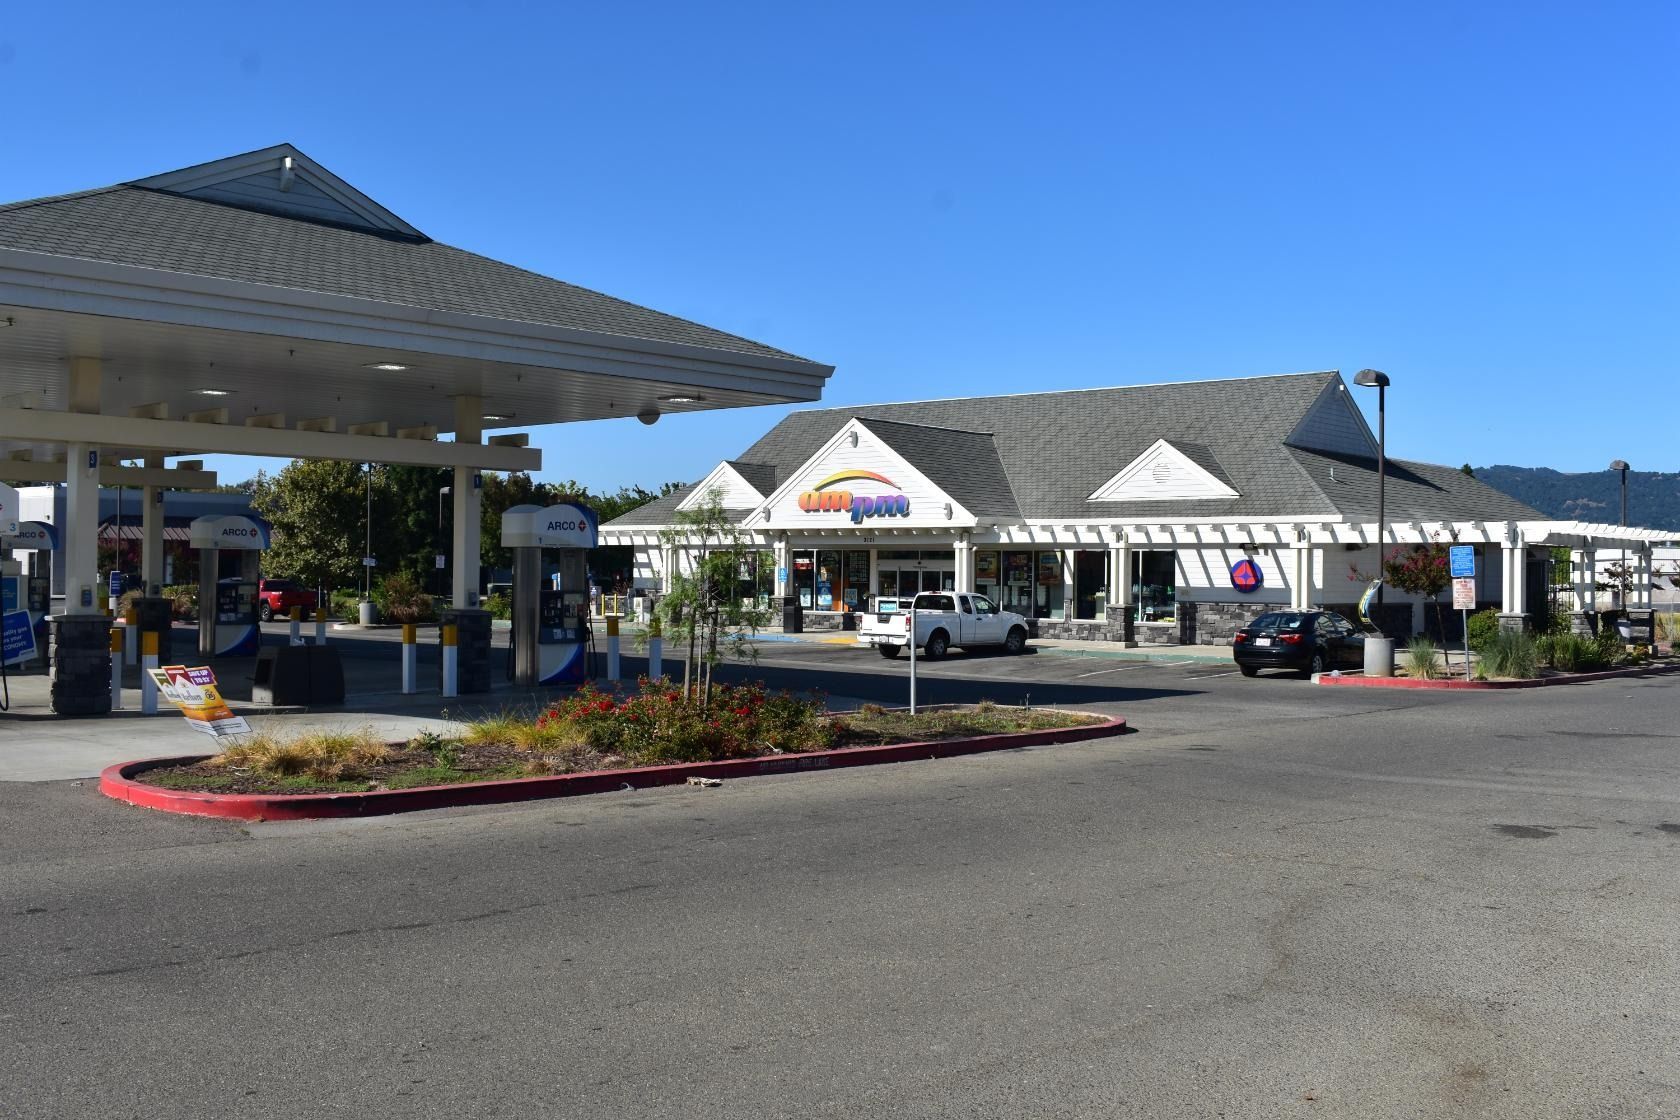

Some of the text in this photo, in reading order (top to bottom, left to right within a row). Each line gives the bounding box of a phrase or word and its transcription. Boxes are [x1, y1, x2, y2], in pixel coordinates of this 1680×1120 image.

[798, 490, 910, 524] ampm
[9, 522, 17, 532] 3
[547, 521, 576, 531] ARCO
[222, 528, 248, 537] ARCO
